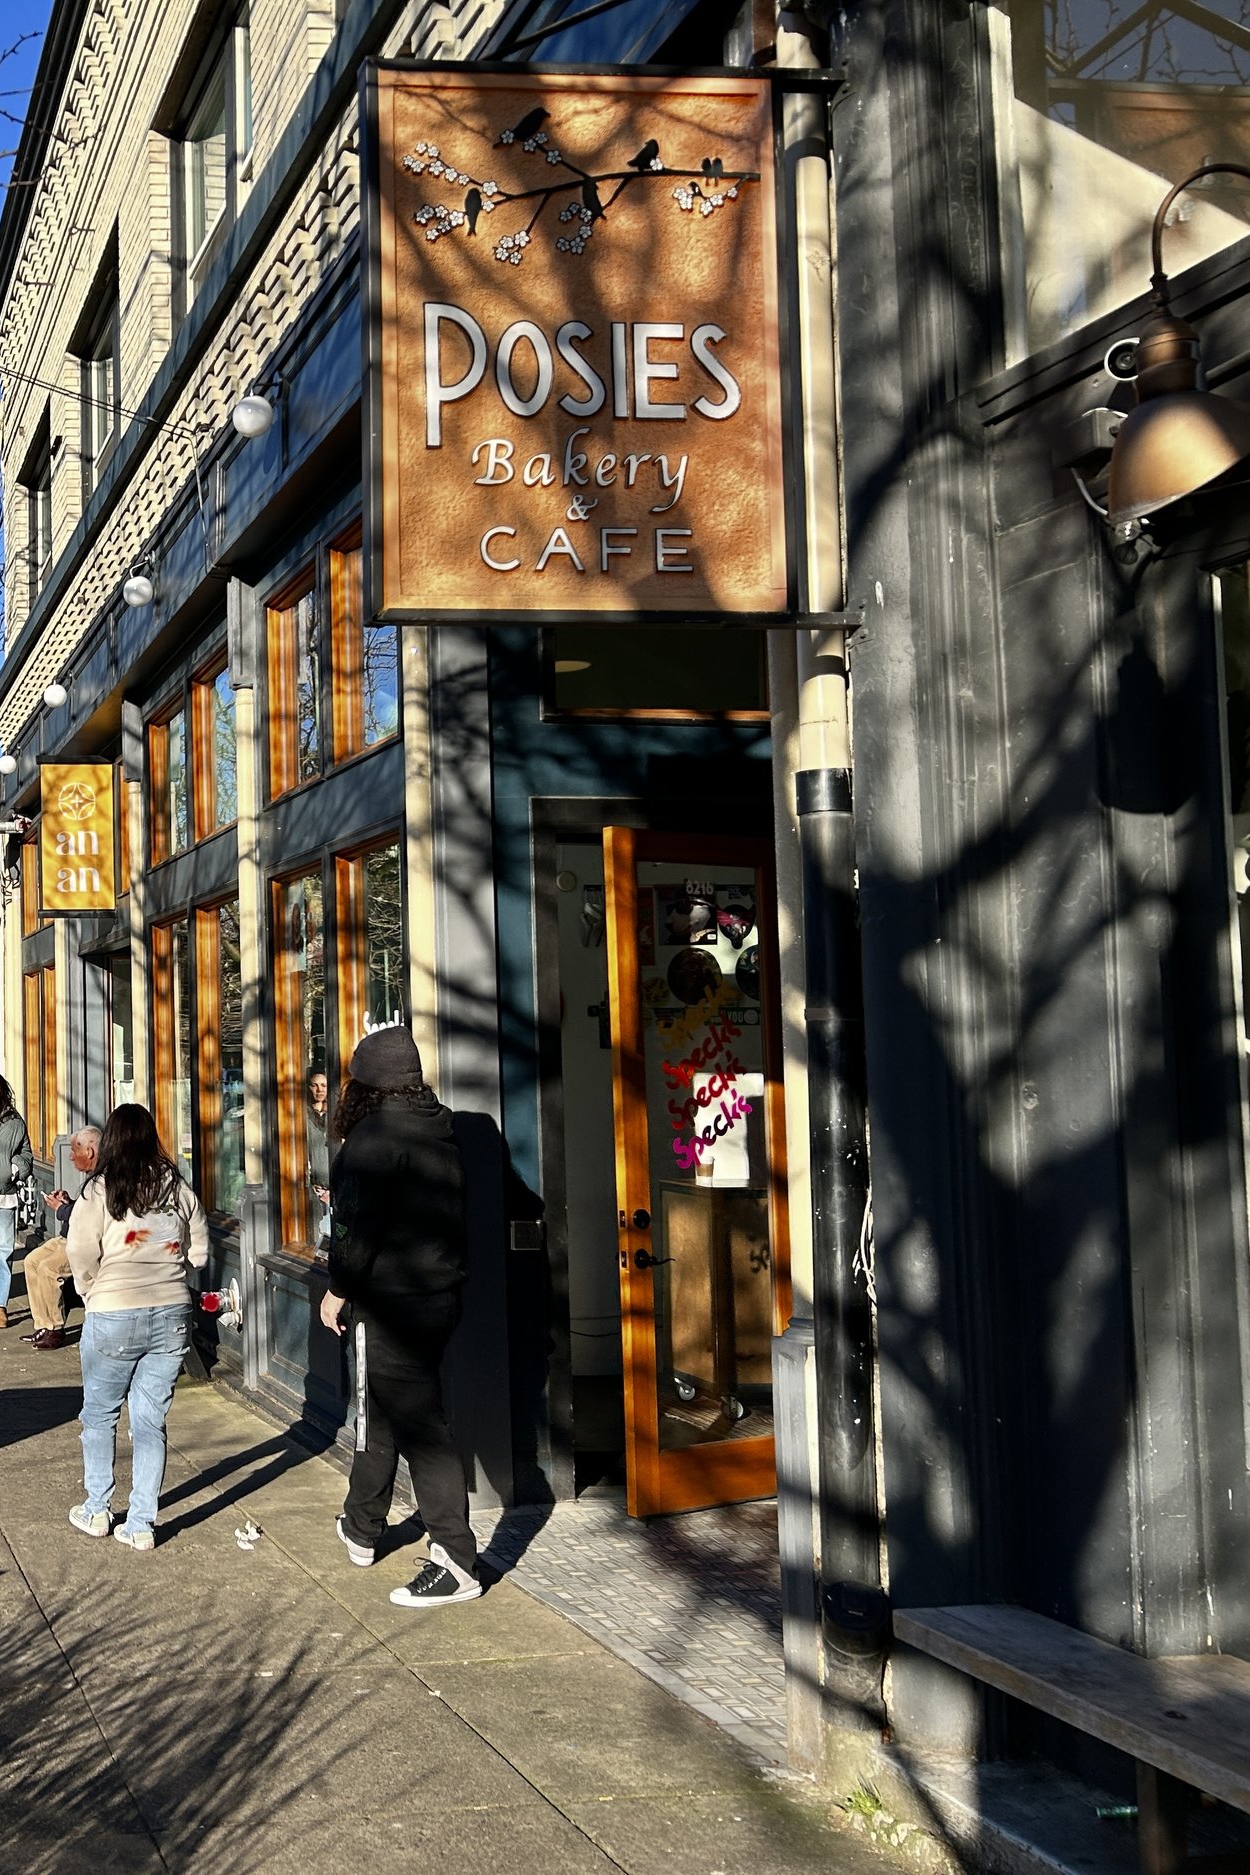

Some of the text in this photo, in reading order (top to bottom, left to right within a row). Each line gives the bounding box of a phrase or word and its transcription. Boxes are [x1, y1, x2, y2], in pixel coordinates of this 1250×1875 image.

[423, 302, 742, 449] POSIES
[470, 427, 689, 513] Bakery
[565, 494, 598, 522] &
[479, 525, 694, 573] CAFE
[55, 830, 99, 856] an
[56, 867, 101, 893] an
[672, 1087, 753, 1169] Speck's
